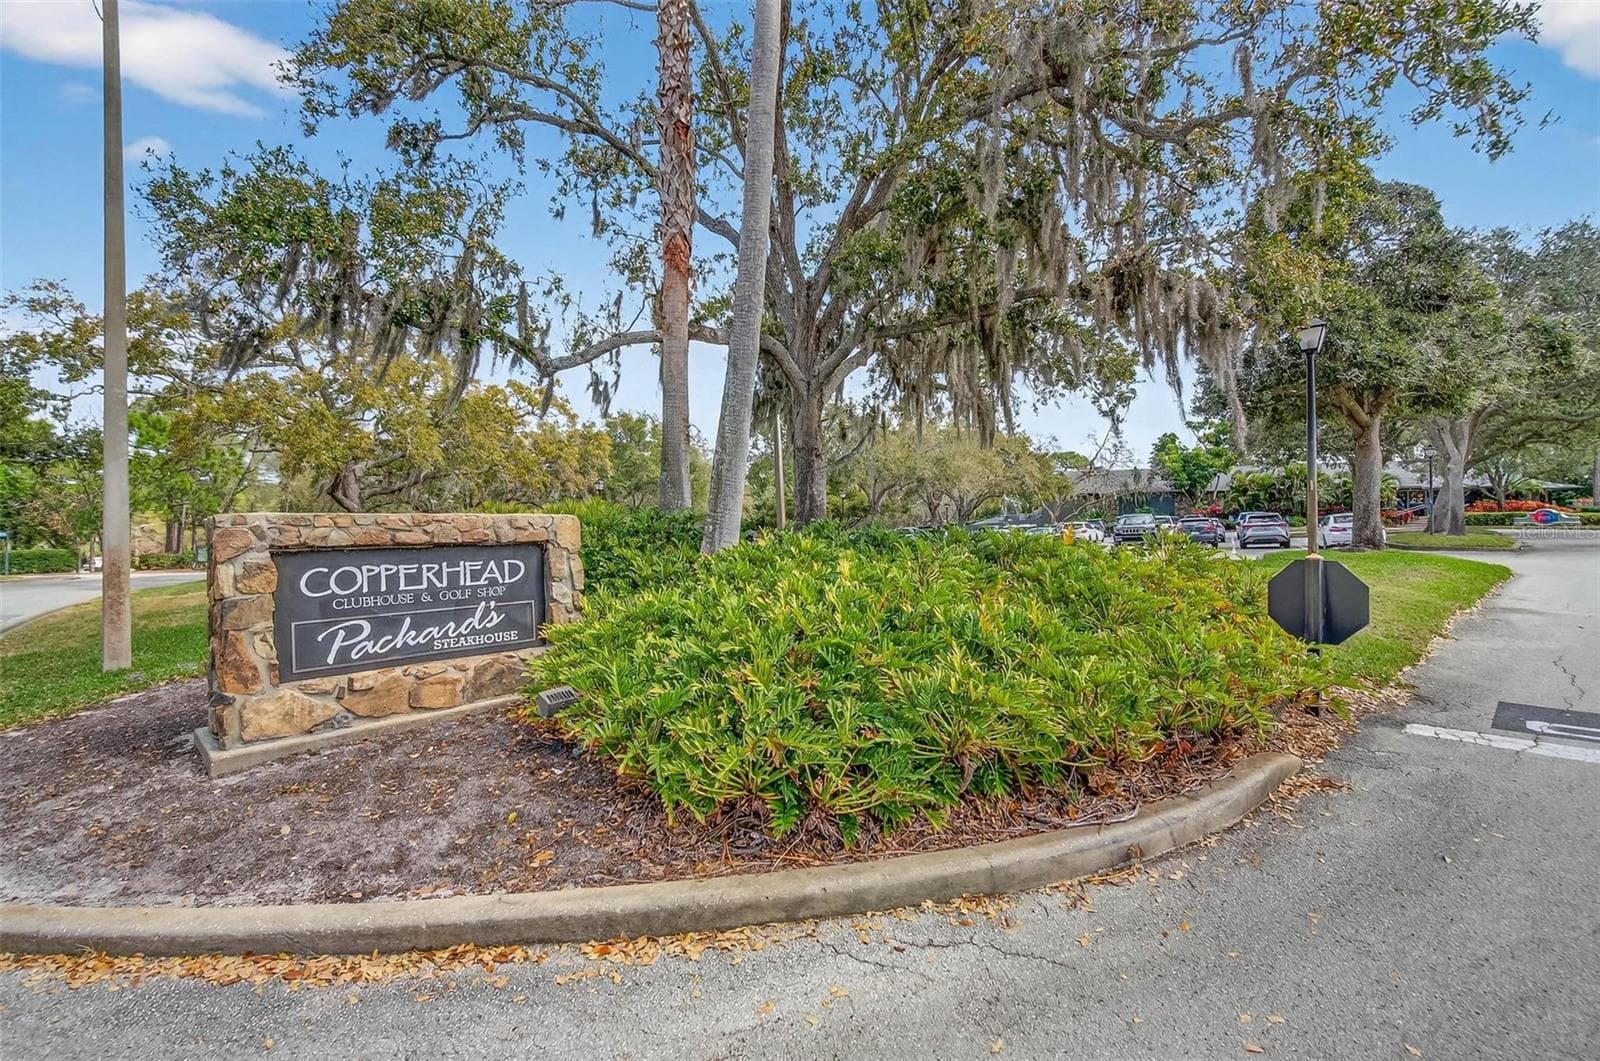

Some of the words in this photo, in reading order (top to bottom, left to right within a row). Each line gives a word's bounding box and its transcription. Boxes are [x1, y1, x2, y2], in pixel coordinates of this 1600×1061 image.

[300, 559, 526, 598] COPPERHEAD
[332, 593, 415, 610] CLUBHOUSE
[421, 592, 433, 602] &
[439, 588, 472, 601] GOLF
[477, 585, 507, 598] SHOP
[318, 600, 506, 665] Packard's
[433, 630, 519, 650] STEAKHOUSE
